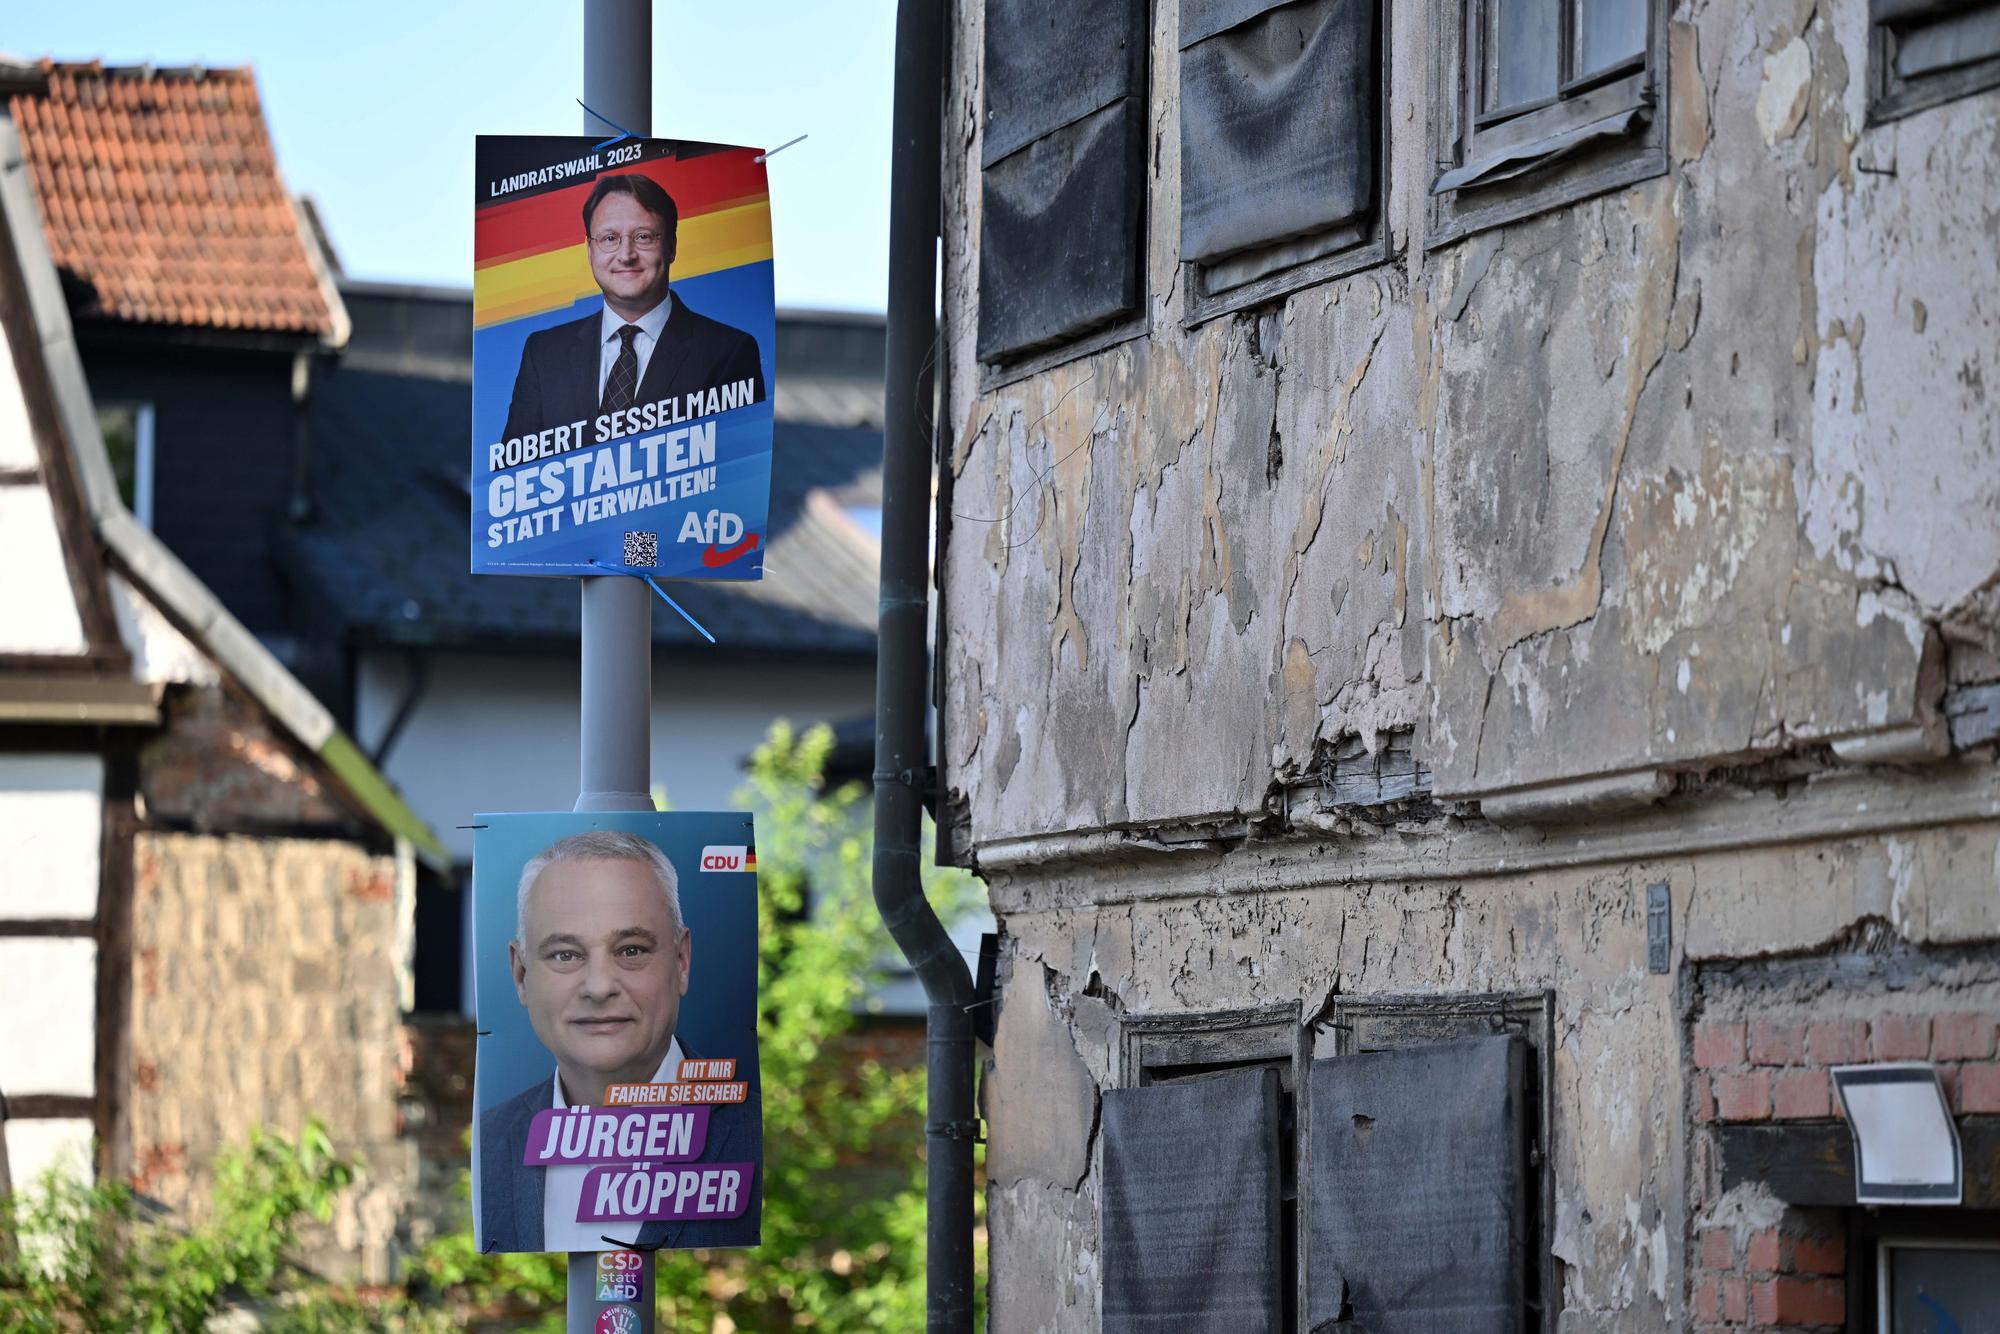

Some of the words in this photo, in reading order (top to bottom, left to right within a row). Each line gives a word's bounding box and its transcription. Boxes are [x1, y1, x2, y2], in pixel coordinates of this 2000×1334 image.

[491, 154, 603, 197] LANDRATSWAHL
[607, 143, 642, 166] 2023
[489, 420, 587, 471] ROBERT
[595, 378, 754, 443] SESSELMANN
[488, 421, 717, 518] GESTALTEN
[487, 506, 564, 548] STATT
[571, 466, 716, 526] VERWALTEN!
[676, 509, 744, 545] AfD
[703, 855, 739, 870] CDU
[681, 1062, 707, 1078] MIT
[708, 1062, 732, 1078] MIR
[609, 1086, 668, 1103] FAHREN
[669, 1085, 692, 1102] SIE
[693, 1084, 744, 1102] SICHER!
[540, 1105, 695, 1160] JÜRGEN
[594, 1162, 741, 1216] KÖPPER
[599, 1253, 643, 1270] CSD
[601, 1273, 637, 1283] statt
[599, 1285, 638, 1299] AFD
[601, 1307, 620, 1321] KEIN
[622, 1308, 636, 1320] ORT
